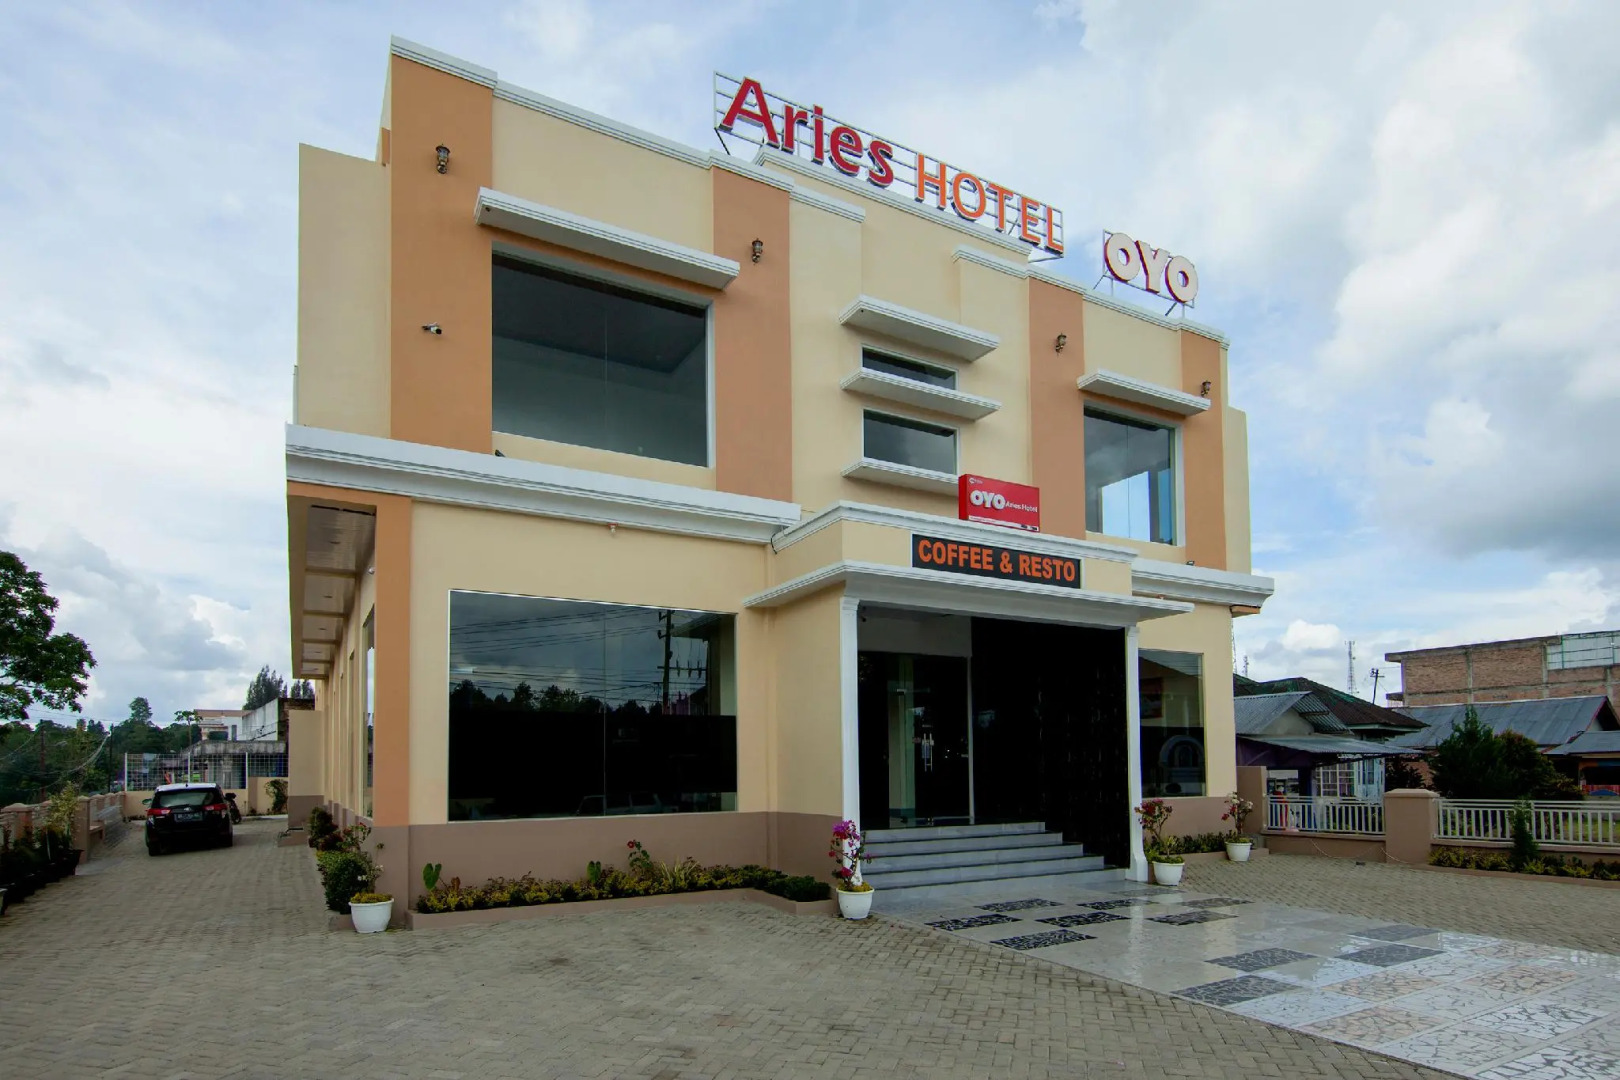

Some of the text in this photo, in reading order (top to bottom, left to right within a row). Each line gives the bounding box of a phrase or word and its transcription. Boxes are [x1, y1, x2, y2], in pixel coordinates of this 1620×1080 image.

[719, 77, 1064, 254] Aries HOTEL
[1104, 232, 1199, 304] OYO
[970, 489, 1006, 510] OYO
[918, 539, 1076, 583] COFFEE & RESTO
